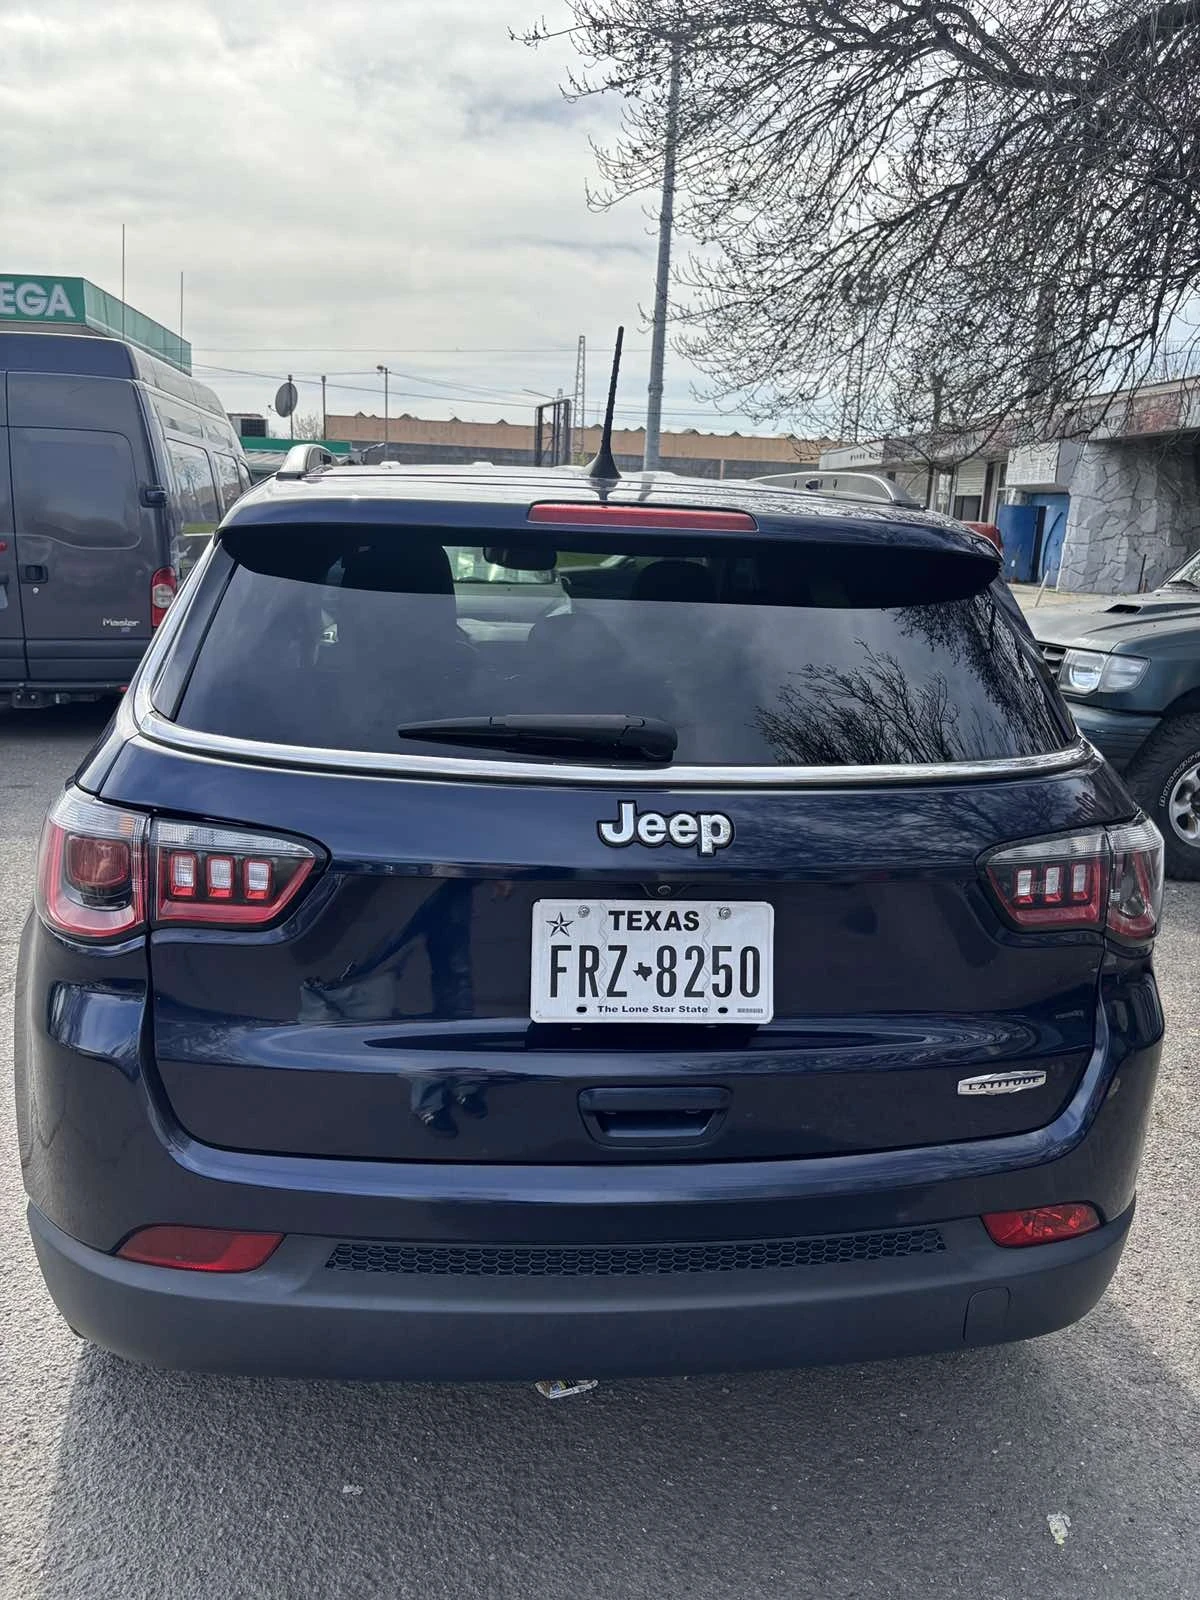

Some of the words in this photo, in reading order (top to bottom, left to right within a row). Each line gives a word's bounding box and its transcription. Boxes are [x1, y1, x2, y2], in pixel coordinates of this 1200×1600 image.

[0, 281, 76, 317] EGA
[103, 617, 140, 627] Master
[599, 801, 733, 855] Jeep
[608, 910, 700, 931] TEXAS
[550, 945, 628, 998] FRZ
[656, 945, 761, 998] 8250
[597, 1005, 619, 1013] The
[622, 1005, 649, 1013] Lone
[652, 1005, 676, 1013] Star
[678, 1005, 709, 1013] State
[967, 1077, 1041, 1091] LATITUDE
